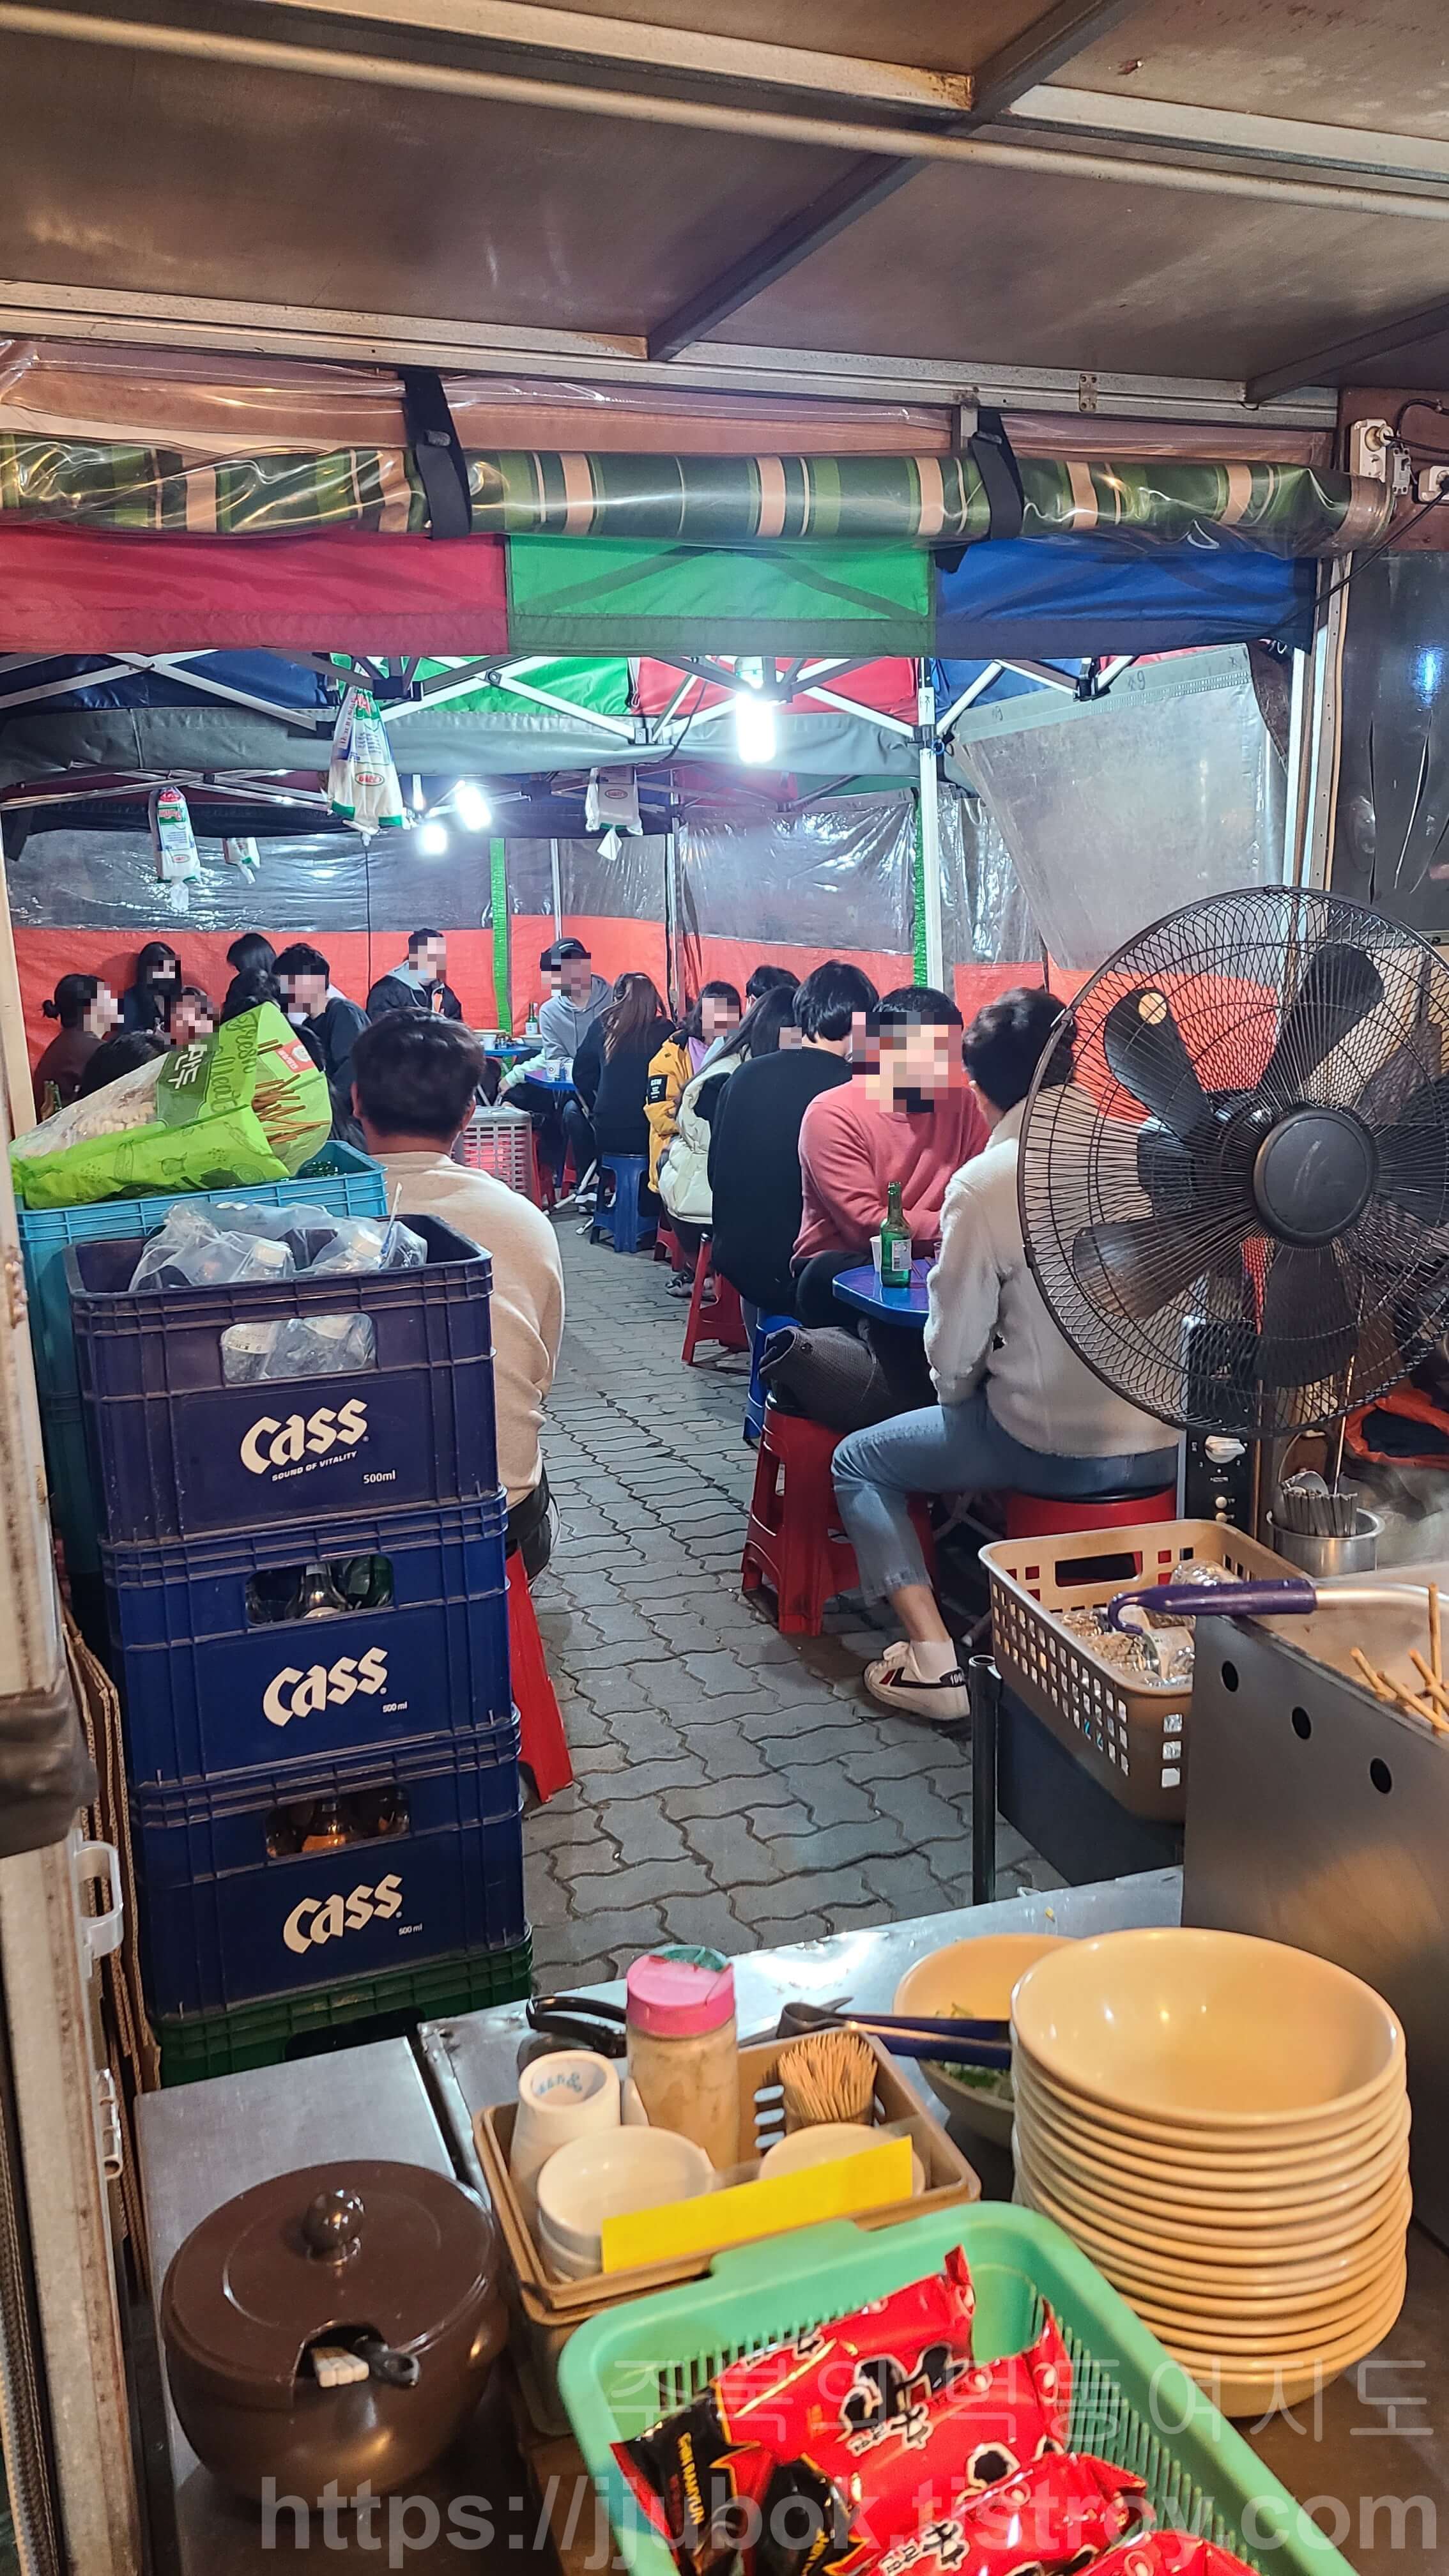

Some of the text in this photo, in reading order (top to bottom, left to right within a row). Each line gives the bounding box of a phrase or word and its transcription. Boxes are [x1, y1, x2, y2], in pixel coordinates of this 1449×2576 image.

[272, 1451, 358, 1482] SOUND OF VITALITY
[364, 1470, 396, 1484] 500ml
